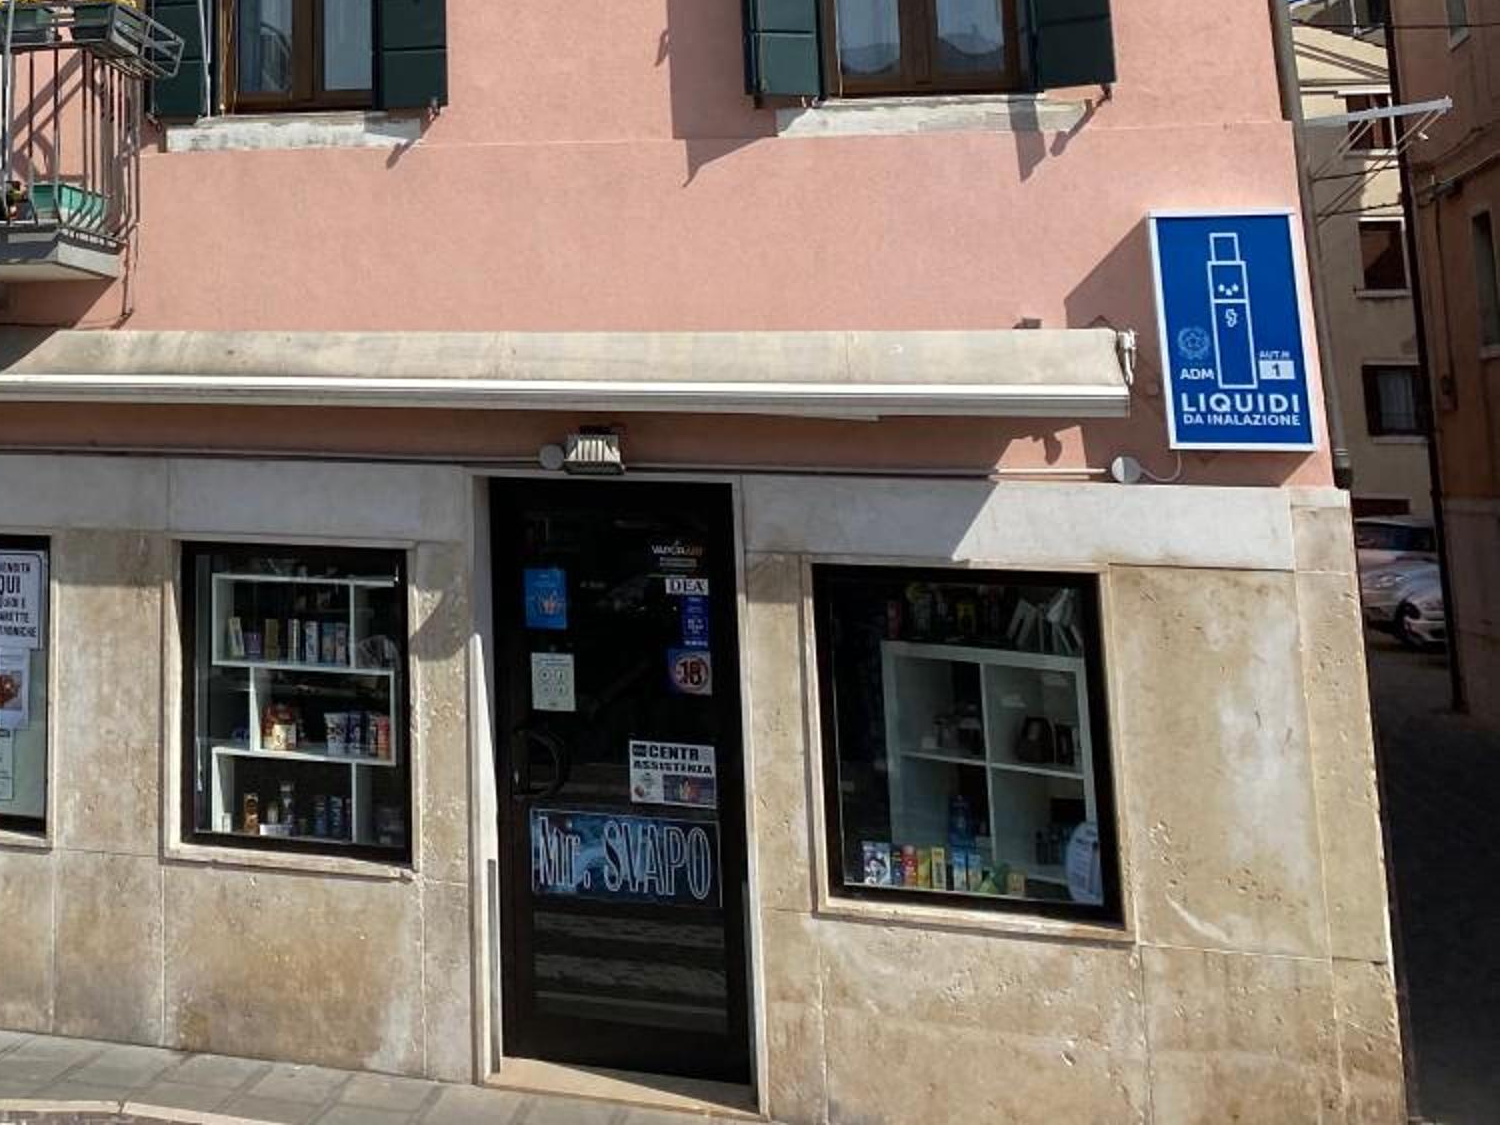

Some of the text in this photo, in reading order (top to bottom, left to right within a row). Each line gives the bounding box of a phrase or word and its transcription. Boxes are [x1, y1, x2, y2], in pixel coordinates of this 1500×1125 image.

[1180, 368, 1215, 380] ADM
[1272, 362, 1281, 378] 1
[1181, 392, 1299, 413] LIQUIDI
[1183, 414, 1301, 426] DA INALAZIONE
[633, 760, 713, 775] ASSISTENZA
[603, 820, 712, 900] SVAPO
